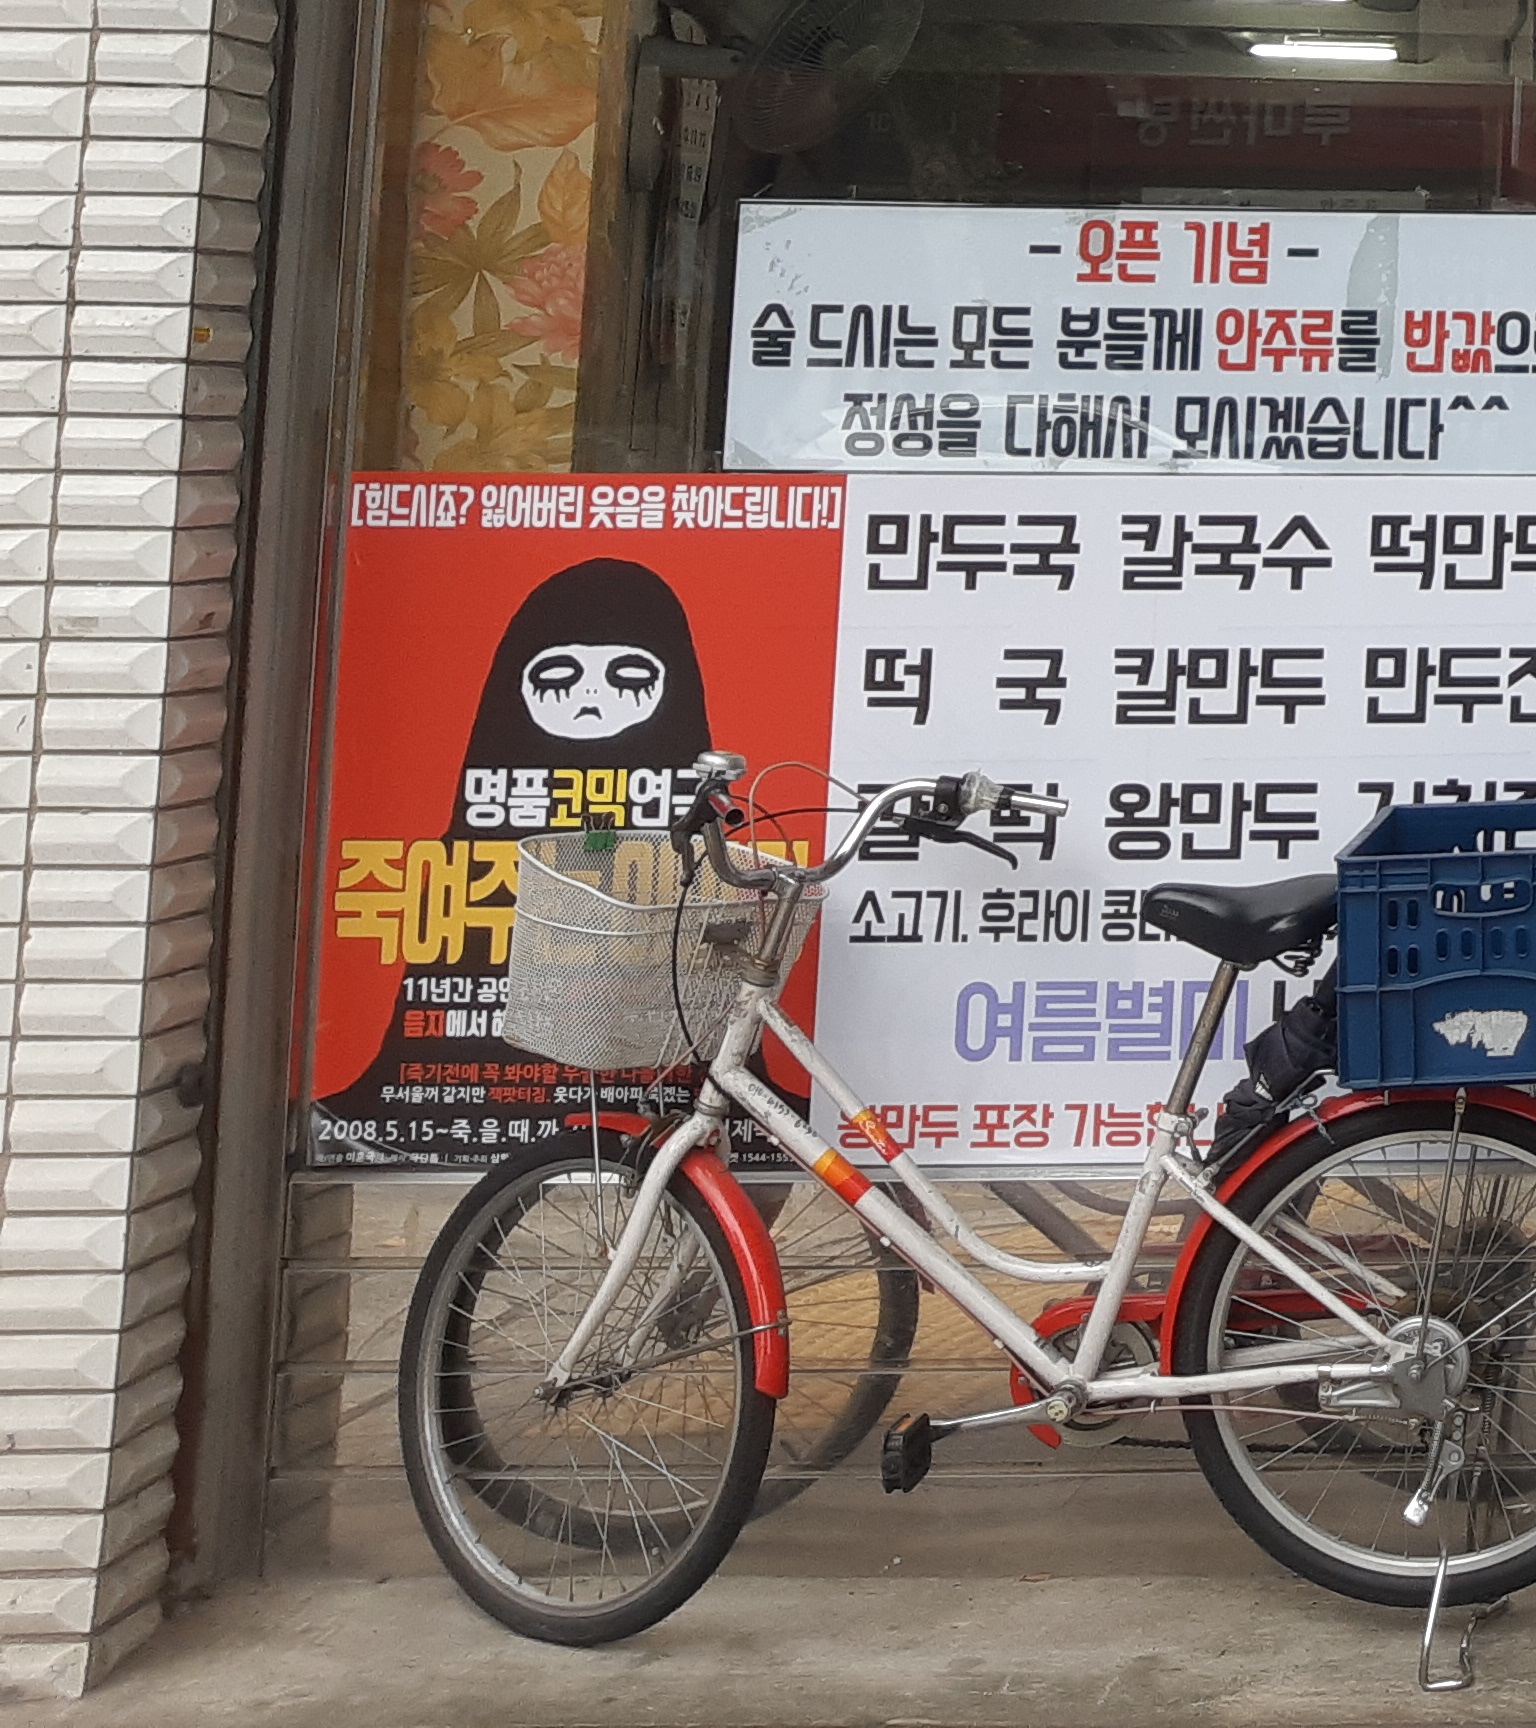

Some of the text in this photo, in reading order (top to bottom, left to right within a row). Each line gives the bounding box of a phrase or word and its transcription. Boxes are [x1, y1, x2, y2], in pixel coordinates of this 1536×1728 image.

[1076, 220, 1271, 285] 오픈 기념
[750, 304, 797, 369] 술
[807, 304, 940, 369] 드시는
[949, 305, 1033, 370] 모든
[1056, 308, 1203, 372] 분들께
[1216, 308, 1382, 373] 안주류를
[840, 392, 982, 457] 정성을
[1004, 393, 1150, 459] 다해서
[480, 484, 584, 529] 잃어버린
[589, 486, 667, 529] 웃음을
[865, 514, 1081, 591] 만두국
[1121, 514, 1333, 591] 칼국수
[863, 647, 934, 726] 떡
[995, 648, 1067, 726] 국
[1113, 647, 1327, 725] 칼만두
[1104, 782, 1320, 861] 왕만두
[979, 889, 1090, 943] 후라이
[402, 976, 474, 1003] 11년간
[403, 1008, 488, 1039] 음지에서
[442, 1086, 487, 1105] 같지만
[970, 1104, 1056, 1149] 포장
